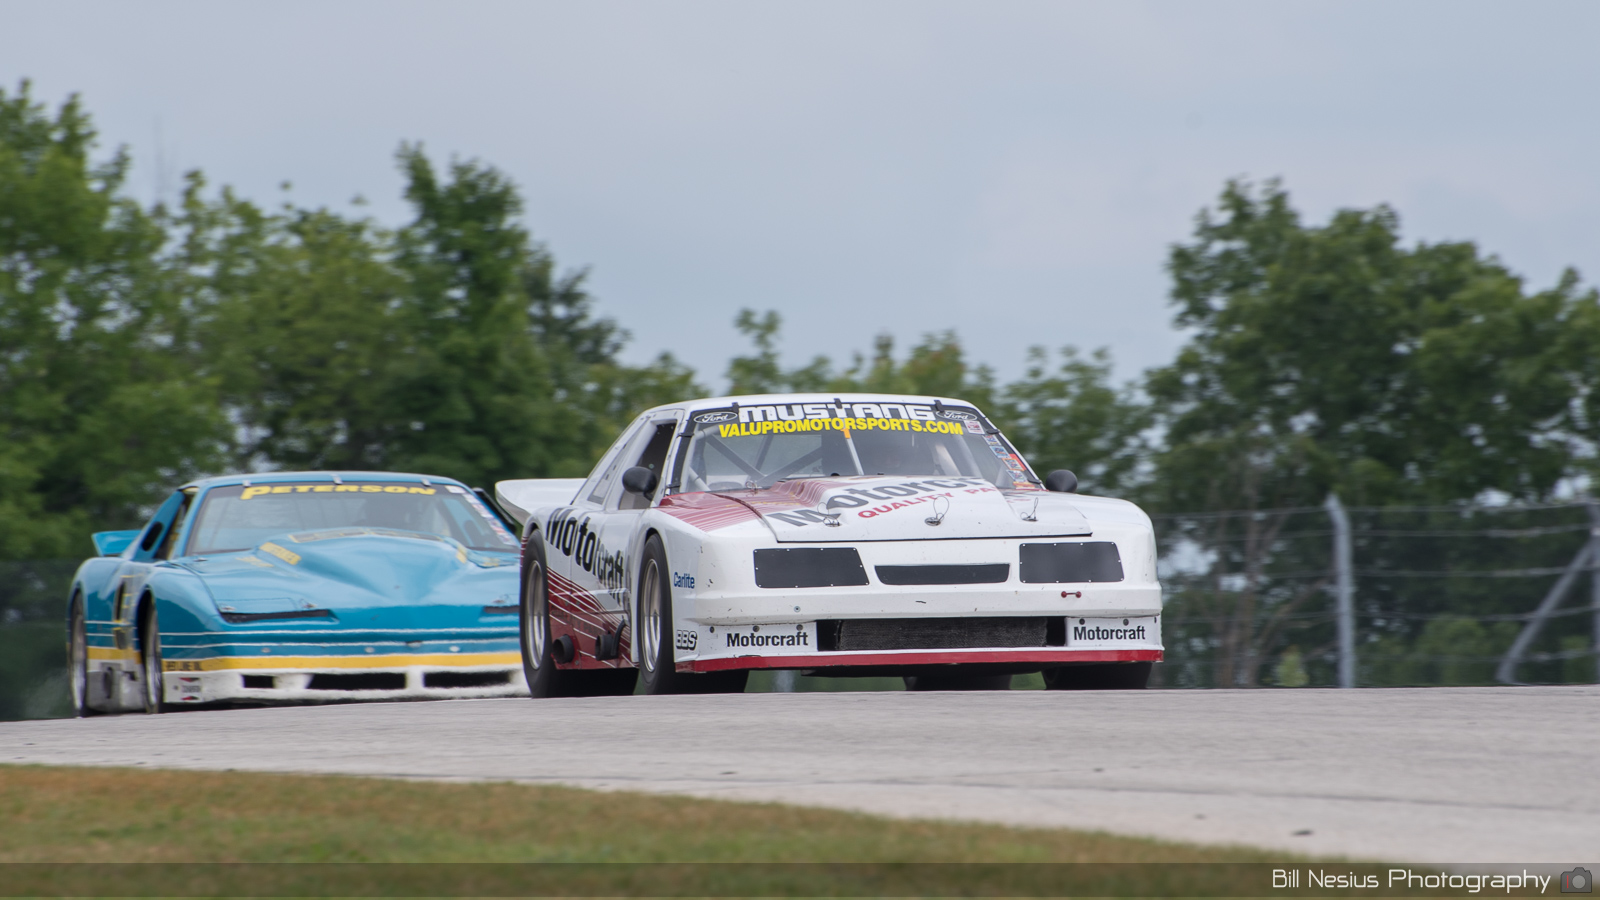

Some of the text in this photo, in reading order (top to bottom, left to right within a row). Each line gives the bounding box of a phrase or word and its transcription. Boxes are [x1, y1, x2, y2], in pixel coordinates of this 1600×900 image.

[702, 412, 729, 423] Ford
[738, 403, 936, 423] MUSTANG
[943, 410, 969, 420] Ford
[718, 417, 963, 438] VALUPROMOTORSPORTS.COM
[240, 484, 437, 500] PETERSON
[858, 492, 954, 518] QUALITY
[674, 571, 695, 589] Carlite
[676, 629, 697, 650] BBS
[727, 631, 809, 648] Motorcraft
[1073, 625, 1146, 641] Motorcraft
